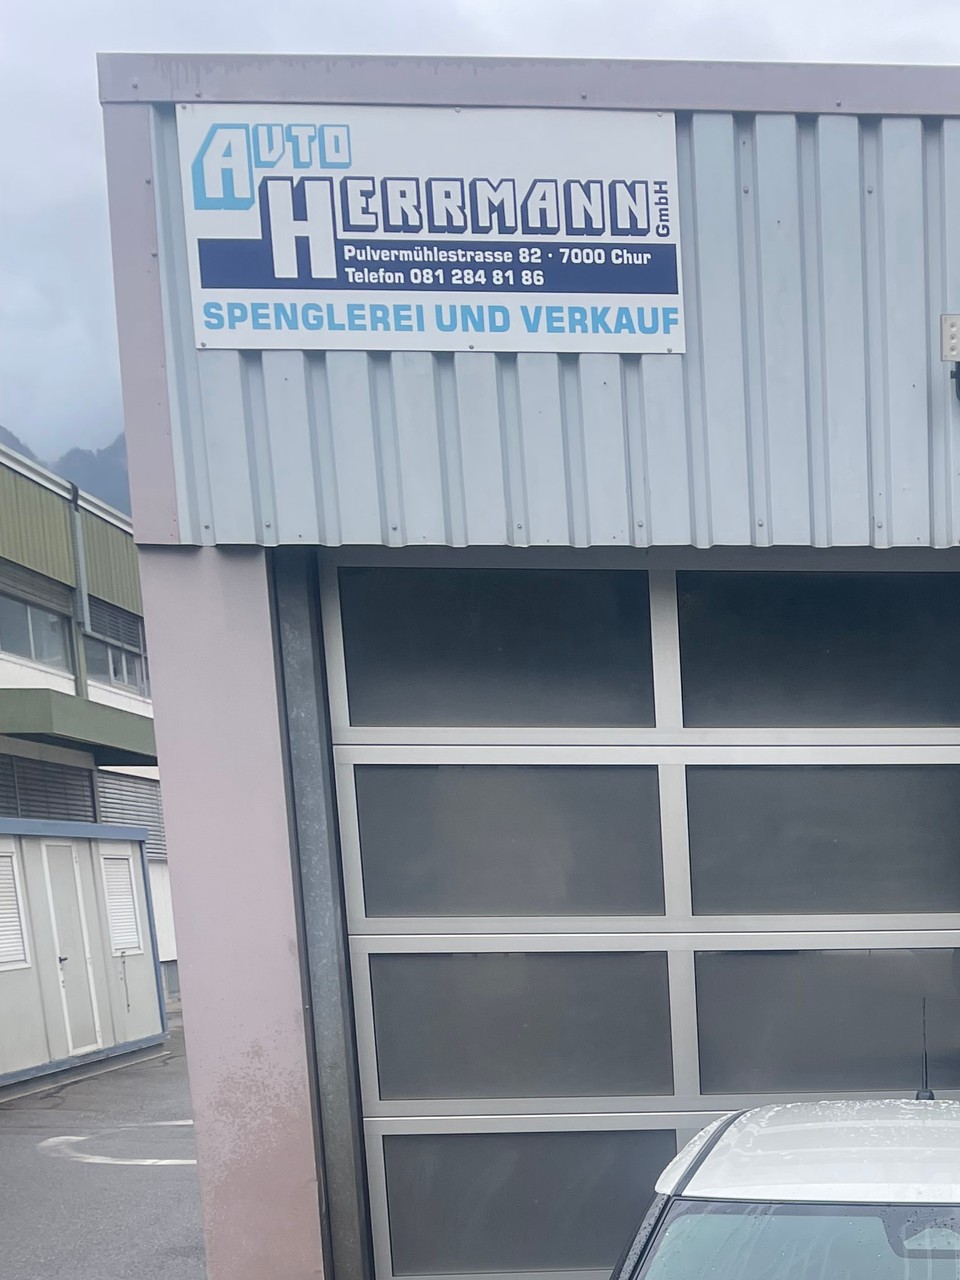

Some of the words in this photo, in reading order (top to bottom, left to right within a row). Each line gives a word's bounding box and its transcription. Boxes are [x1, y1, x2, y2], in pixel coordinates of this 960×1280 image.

[192, 123, 351, 210] AUTO
[258, 175, 650, 279] HERRMANN
[655, 180, 670, 238] GmbH
[343, 245, 513, 264] Pulvermühlestrasse
[518, 247, 542, 264] 82
[559, 248, 605, 265] 7000
[611, 248, 652, 265] Chur
[344, 267, 405, 285] Telefon
[410, 268, 444, 285] 081
[451, 269, 487, 286] 284
[492, 270, 515, 286] 81
[521, 270, 544, 287] 86
[203, 301, 424, 332] SPENGLEREI
[435, 304, 510, 334] UND
[520, 305, 680, 335] VERKAUF
